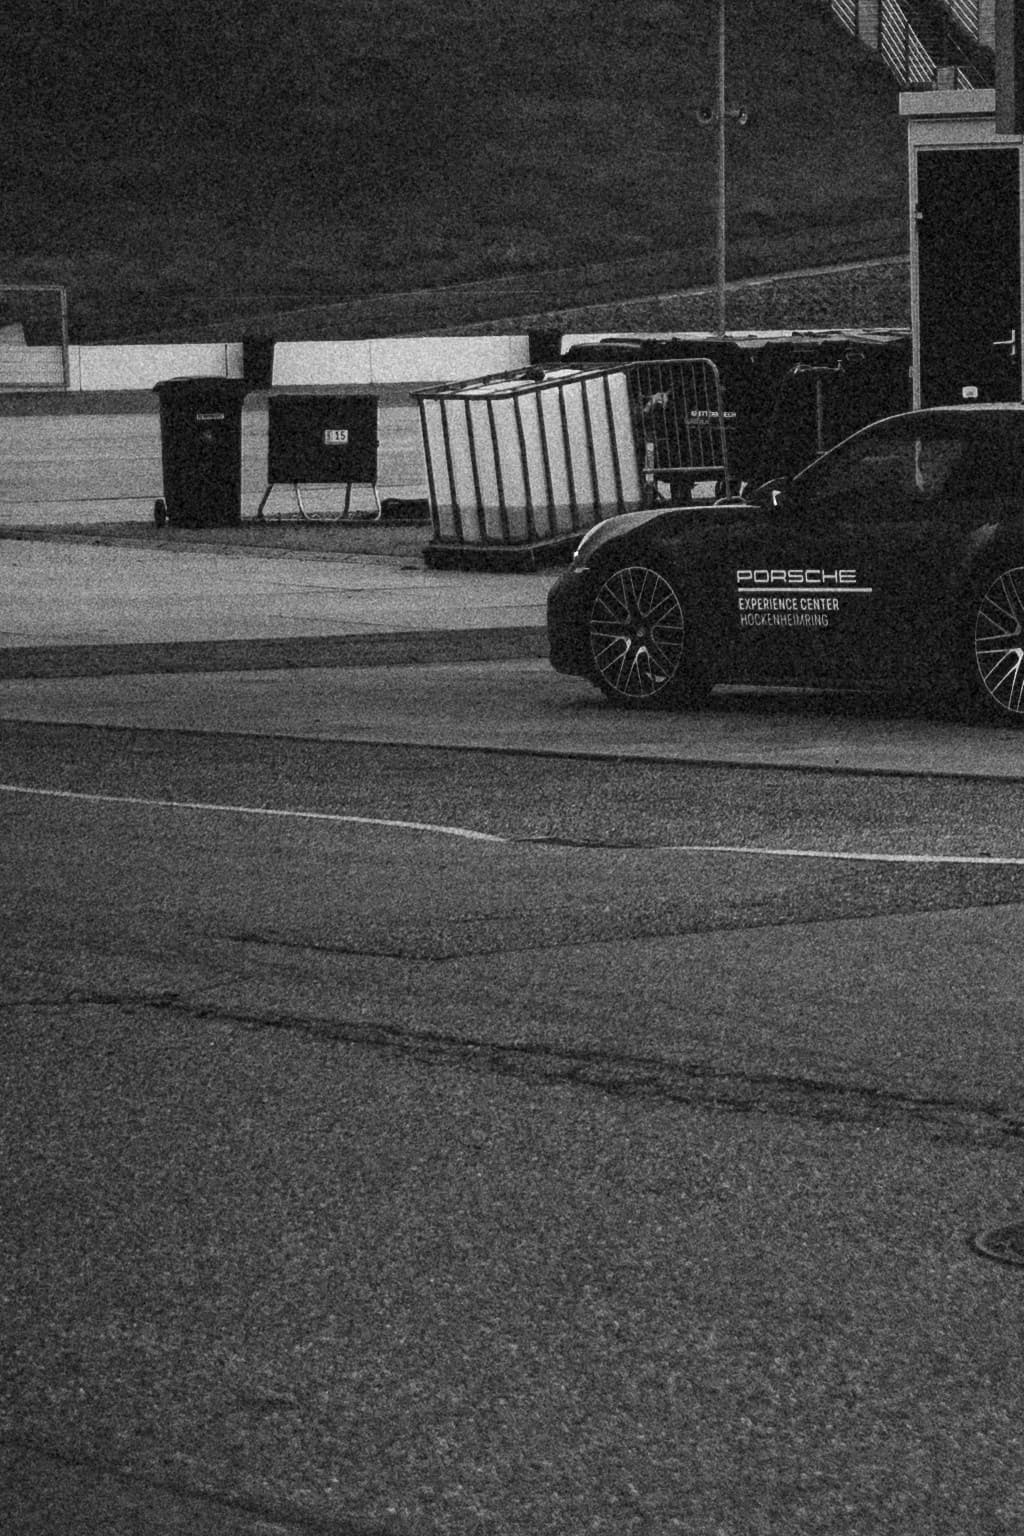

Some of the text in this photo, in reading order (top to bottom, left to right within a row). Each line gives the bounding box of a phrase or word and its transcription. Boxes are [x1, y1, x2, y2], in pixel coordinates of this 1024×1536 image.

[736, 569, 857, 584] PORSCHE
[738, 597, 840, 611] EXPERIENCE CENTER
[740, 613, 829, 627] HOCKENHEIMRING
